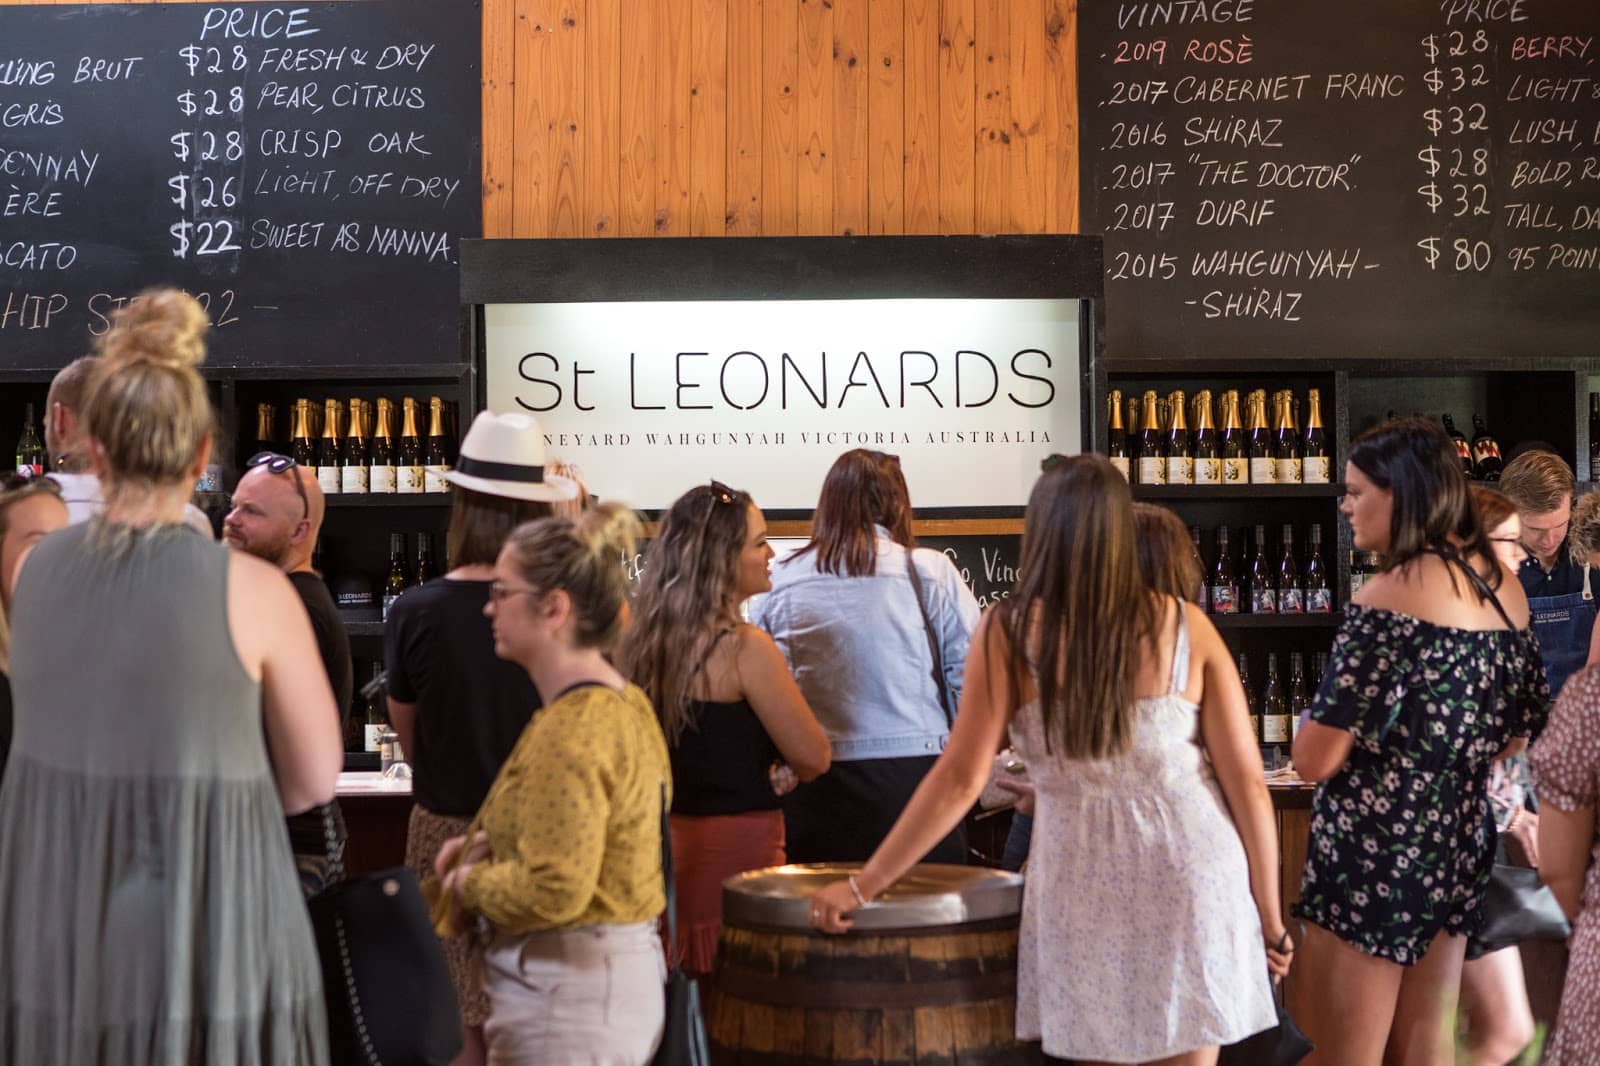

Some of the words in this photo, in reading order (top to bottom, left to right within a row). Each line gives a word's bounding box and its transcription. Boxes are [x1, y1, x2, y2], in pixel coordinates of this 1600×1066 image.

[200, 8, 320, 40] PRICE
[1119, 0, 1253, 29] VINTAGE
[1441, 0, 1528, 25] PRICE
[73, 57, 143, 83] BRUT
[179, 44, 247, 76] $28
[258, 47, 346, 72] FRESH
[350, 50, 369, 66] &
[376, 44, 434, 72] DRY
[177, 87, 243, 116] $28
[1174, 75, 1310, 103] CABERNET
[1325, 73, 1404, 99] FRANC
[1507, 75, 1590, 102] LIGHT
[171, 131, 242, 162] $28
[261, 129, 341, 158] CRISP
[369, 132, 432, 154] OAK
[1509, 119, 1582, 150] LUSH,
[1580, 155, 1600, 182] R
[168, 174, 235, 210] $26
[352, 173, 393, 194] OFF
[400, 176, 460, 209] DRY
[1197, 200, 1274, 226] DURIF
[170, 219, 241, 258] $22
[251, 219, 324, 248] SWEET
[331, 223, 359, 252] AS
[1508, 247, 1540, 270] 95
[1545, 242, 1600, 272] POIN
[2, 292, 68, 329] HIP
[515, 352, 595, 412] St
[628, 348, 1056, 411] LEONARDS
[646, 433, 784, 445] WAHGUNYAH
[802, 432, 909, 444] VICTORIA
[929, 431, 1050, 443] AUSTRALIA
